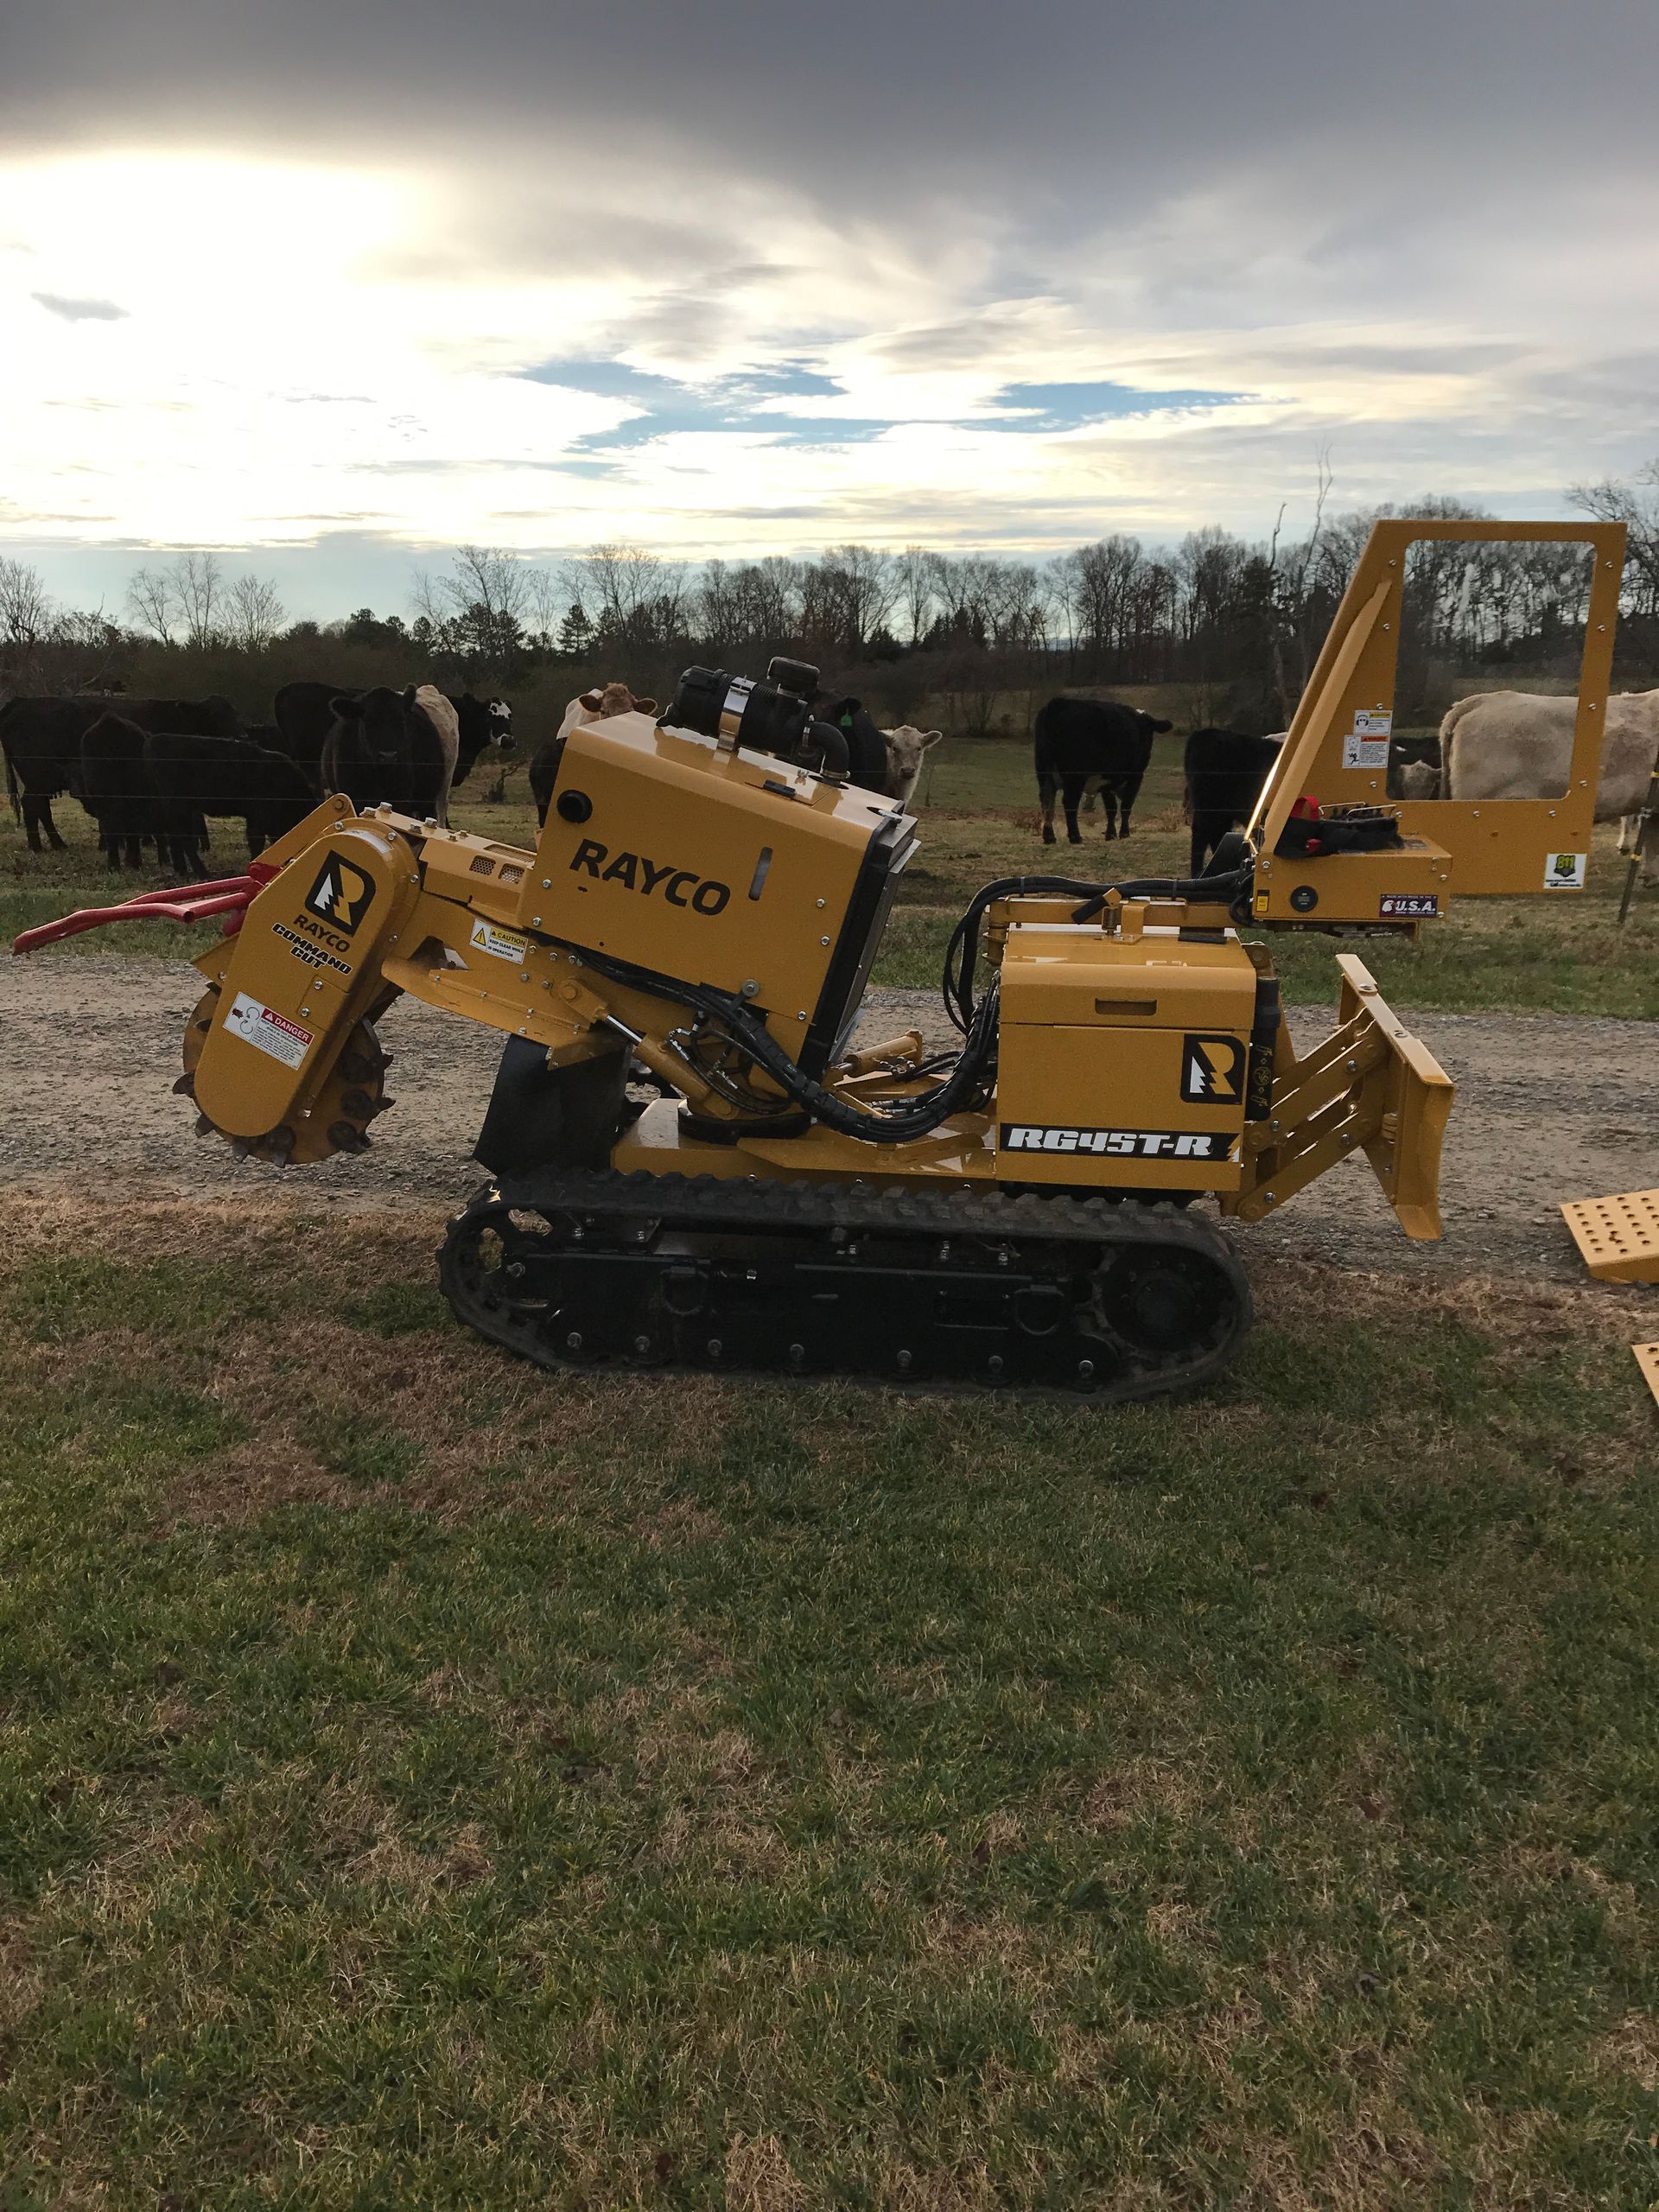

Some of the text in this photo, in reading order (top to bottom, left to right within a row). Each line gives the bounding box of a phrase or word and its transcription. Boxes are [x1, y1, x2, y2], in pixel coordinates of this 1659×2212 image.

[569, 839, 731, 916] RAYCO
[1395, 900, 1436, 912] U.S.A.
[293, 914, 351, 953] RAYCO
[498, 932, 526, 946] CAUTION
[271, 922, 353, 976] COMMAND
[290, 945, 326, 969] CUT
[274, 1017, 309, 1041] DANGER
[1007, 1128, 1212, 1157] RG45T-R
